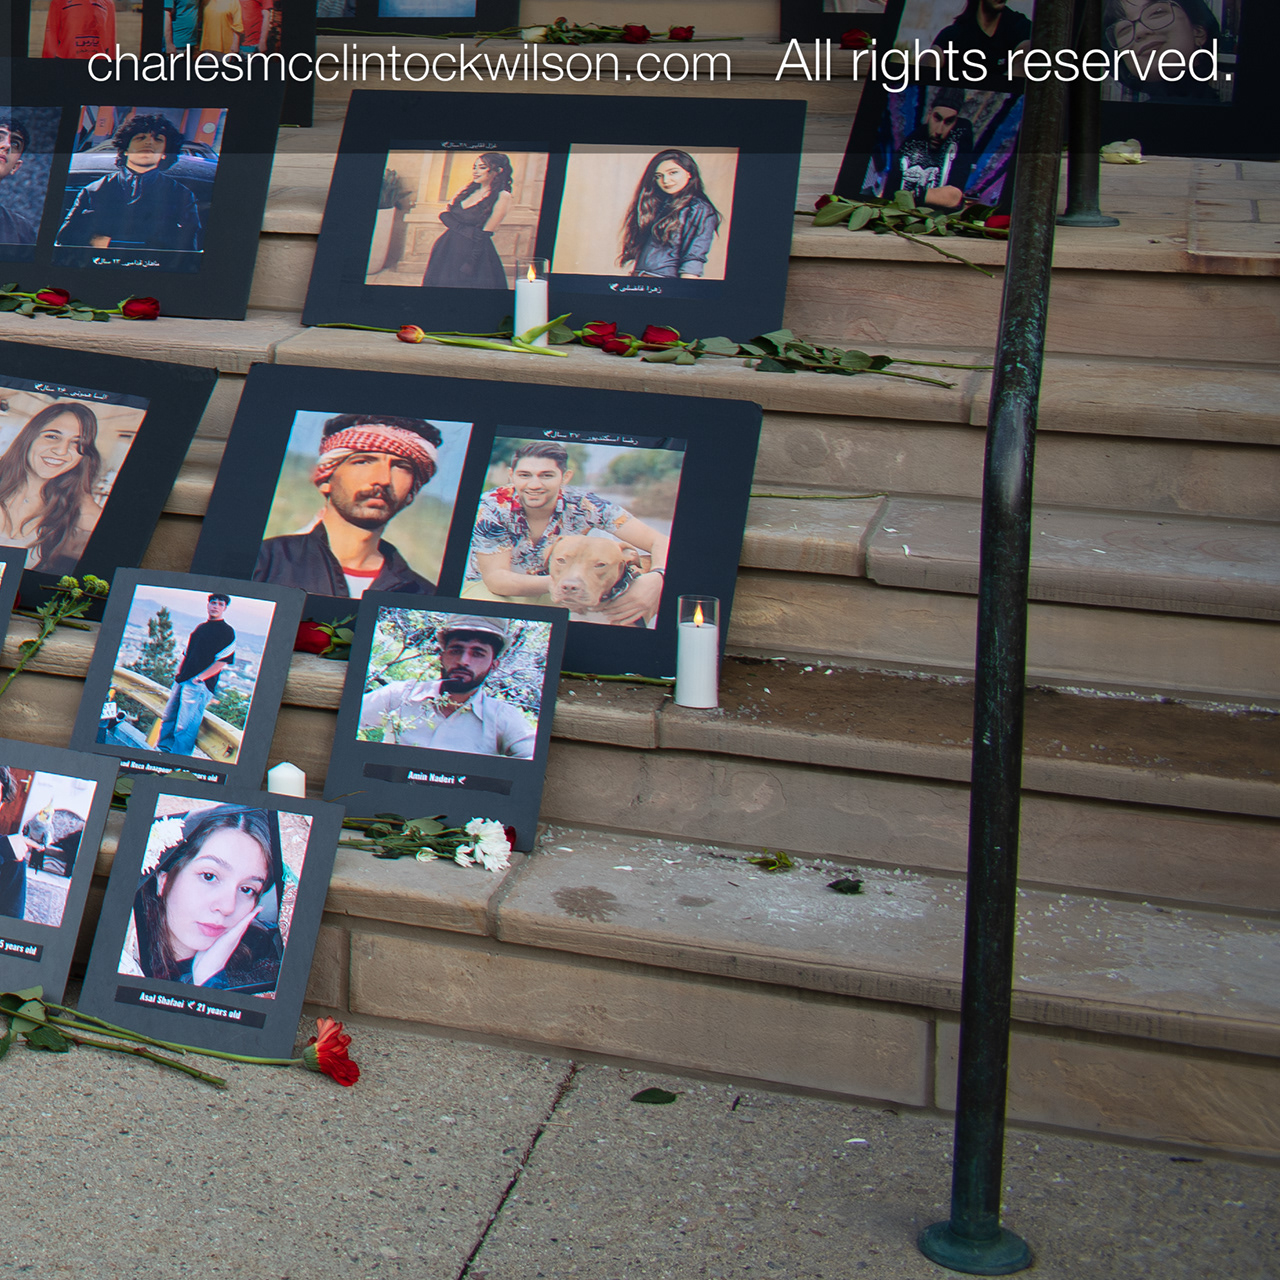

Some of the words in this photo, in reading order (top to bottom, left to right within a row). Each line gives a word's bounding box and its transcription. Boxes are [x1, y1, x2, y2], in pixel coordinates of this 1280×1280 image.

[407, 770, 428, 781] Amin
[428, 772, 455, 785] Naderi
[4, 941, 24, 953] years
[24, 945, 38, 956] old
[139, 991, 157, 1004] Asal
[157, 995, 185, 1009] Shafaei
[196, 1002, 207, 1013] 21
[206, 1005, 228, 1018] years
[228, 1009, 242, 1020] old
